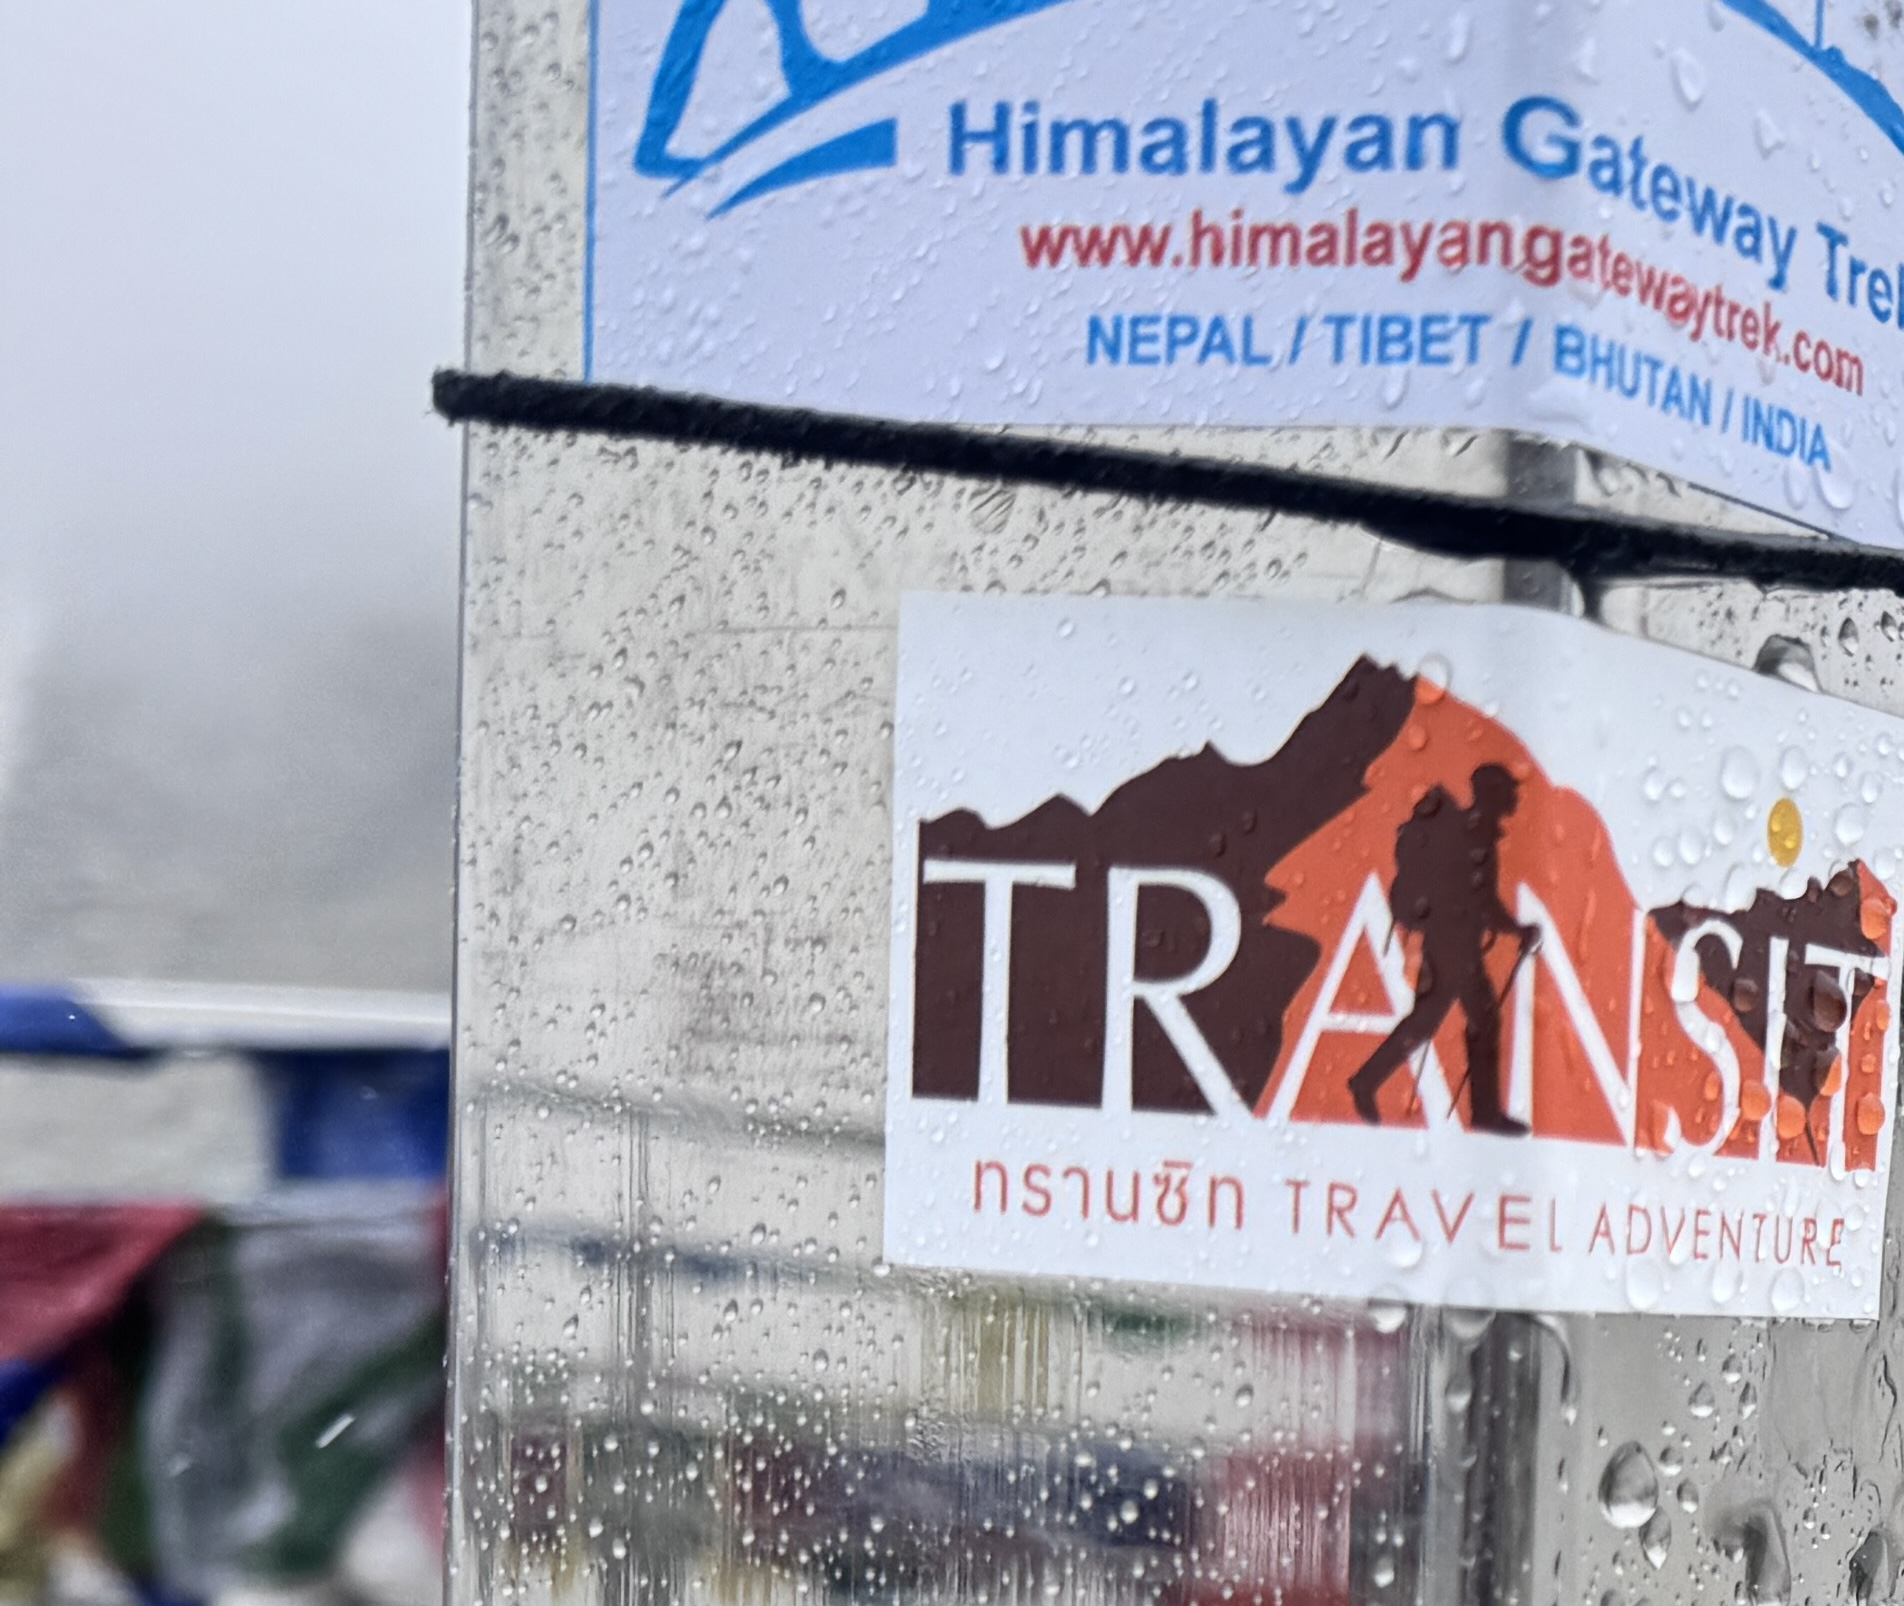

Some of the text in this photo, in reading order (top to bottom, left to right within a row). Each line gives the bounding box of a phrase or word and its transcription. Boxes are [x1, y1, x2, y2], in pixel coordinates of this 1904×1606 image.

[947, 97, 1460, 194] Himalayan
[1501, 95, 1798, 292] Gateway
[1018, 206, 1864, 396] www.himalayangatewaytrek.com
[1085, 313, 1273, 367] NEPAL
[1323, 312, 1492, 367] TIBET
[1551, 322, 1712, 428] BHUTAN
[1741, 396, 1832, 472] INDIA
[922, 858, 1890, 1176] TRANSIT
[972, 1158, 1846, 1267] ทรานซิท TRAVEL ADVENTURE
